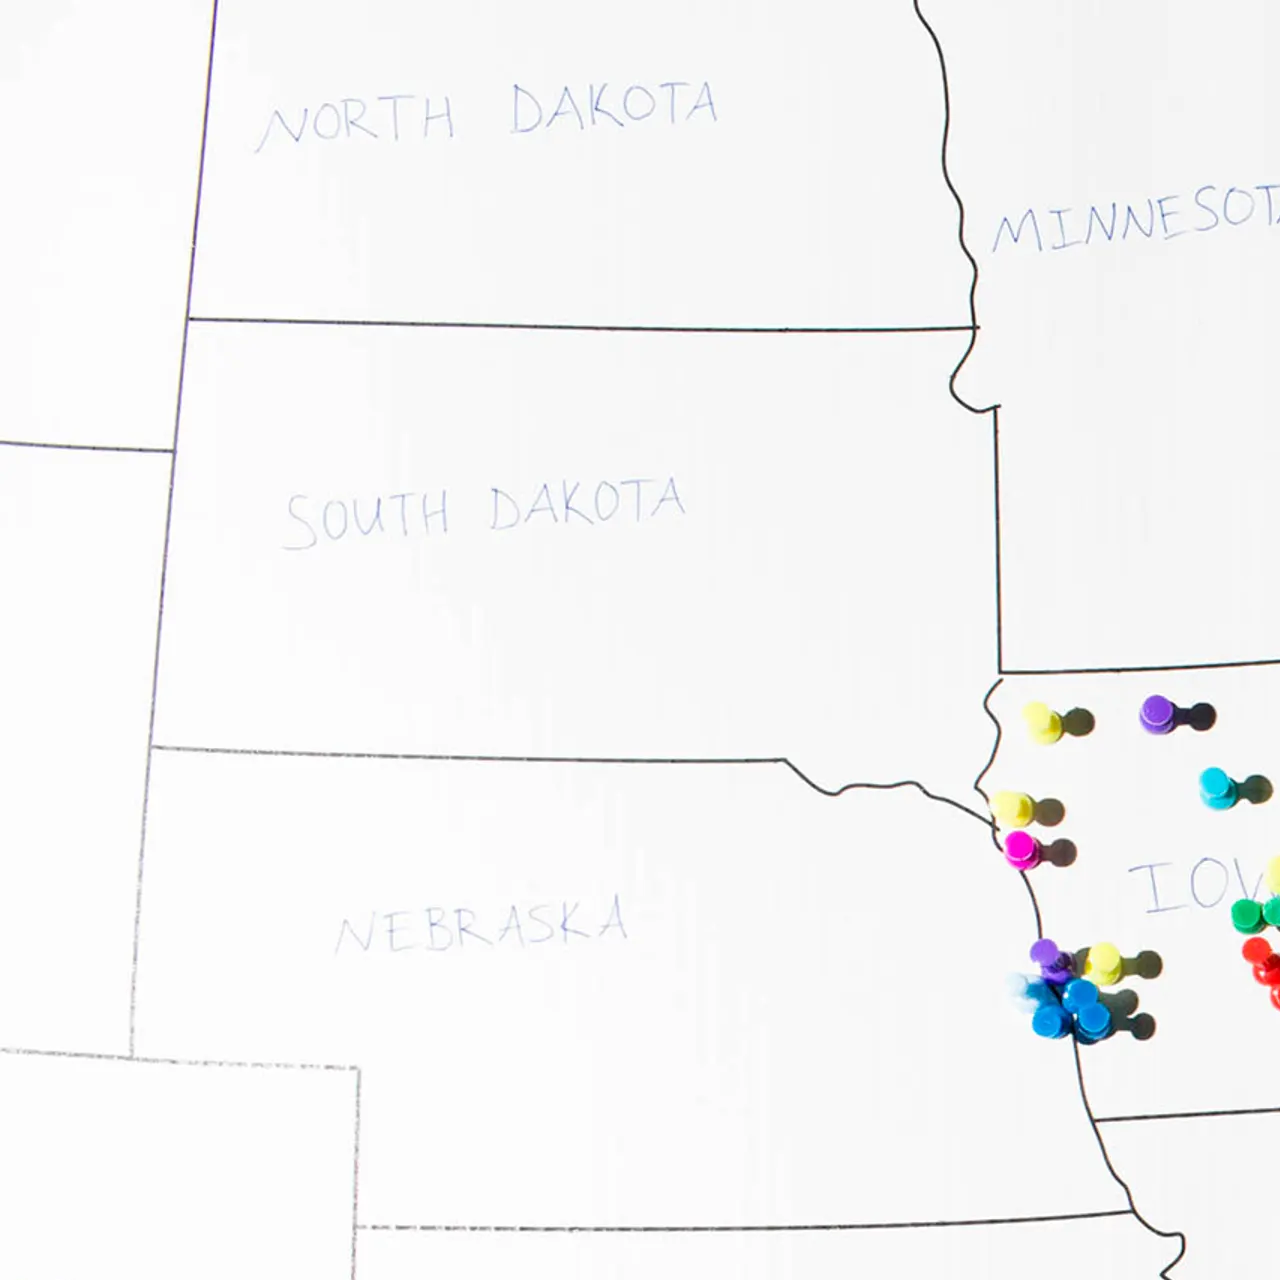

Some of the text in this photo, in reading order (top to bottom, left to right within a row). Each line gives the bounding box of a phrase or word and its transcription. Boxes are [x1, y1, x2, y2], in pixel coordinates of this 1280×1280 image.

[255, 81, 717, 153] NORTH DAKOTA
[281, 476, 686, 551] SOUTH DAKOTA
[333, 892, 629, 957] NEBRASKA
